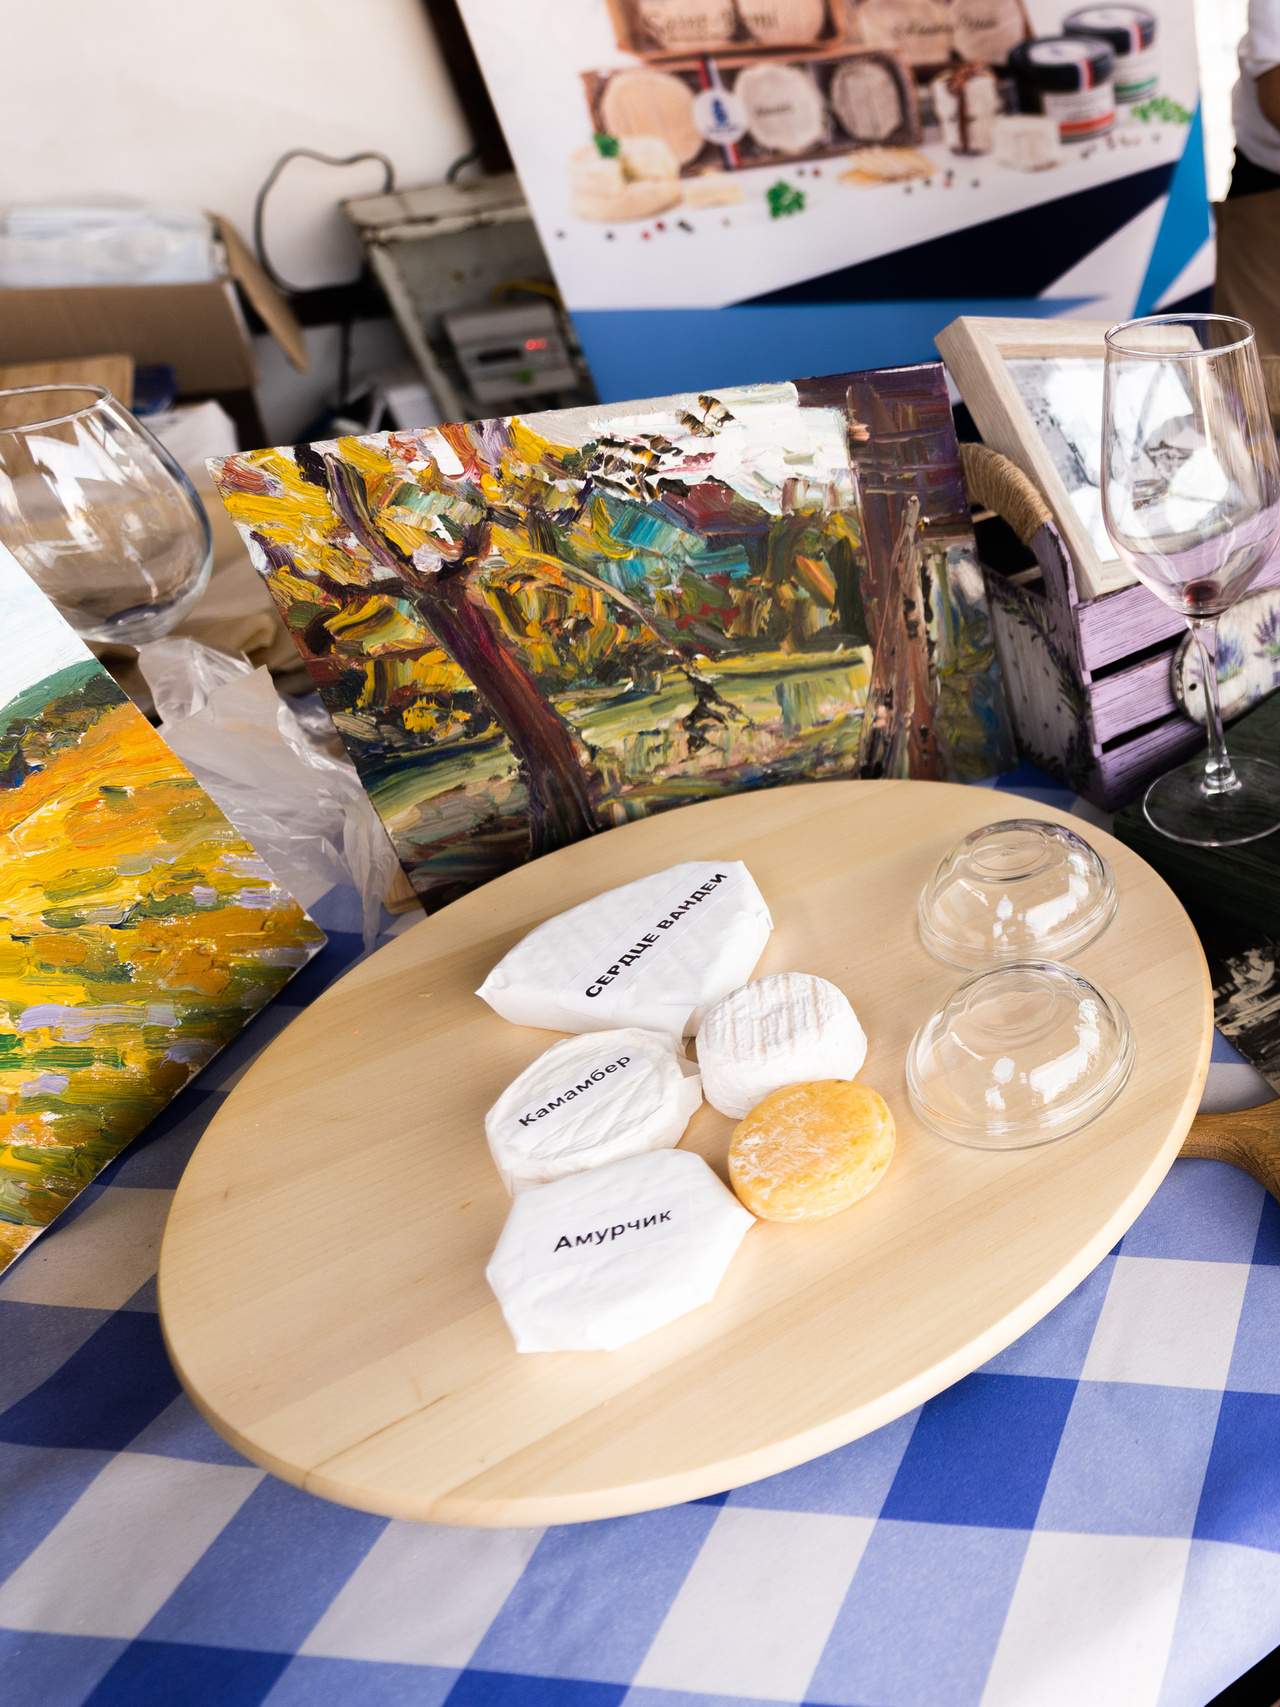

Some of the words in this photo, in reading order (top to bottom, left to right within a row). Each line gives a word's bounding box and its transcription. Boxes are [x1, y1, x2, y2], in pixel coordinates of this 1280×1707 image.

[585, 932, 660, 999] СЕРДЦЕ
[656, 872, 728, 931] ВАНДЕИ
[518, 1055, 631, 1127] Камамбер
[553, 1209, 673, 1253] Амурчик
